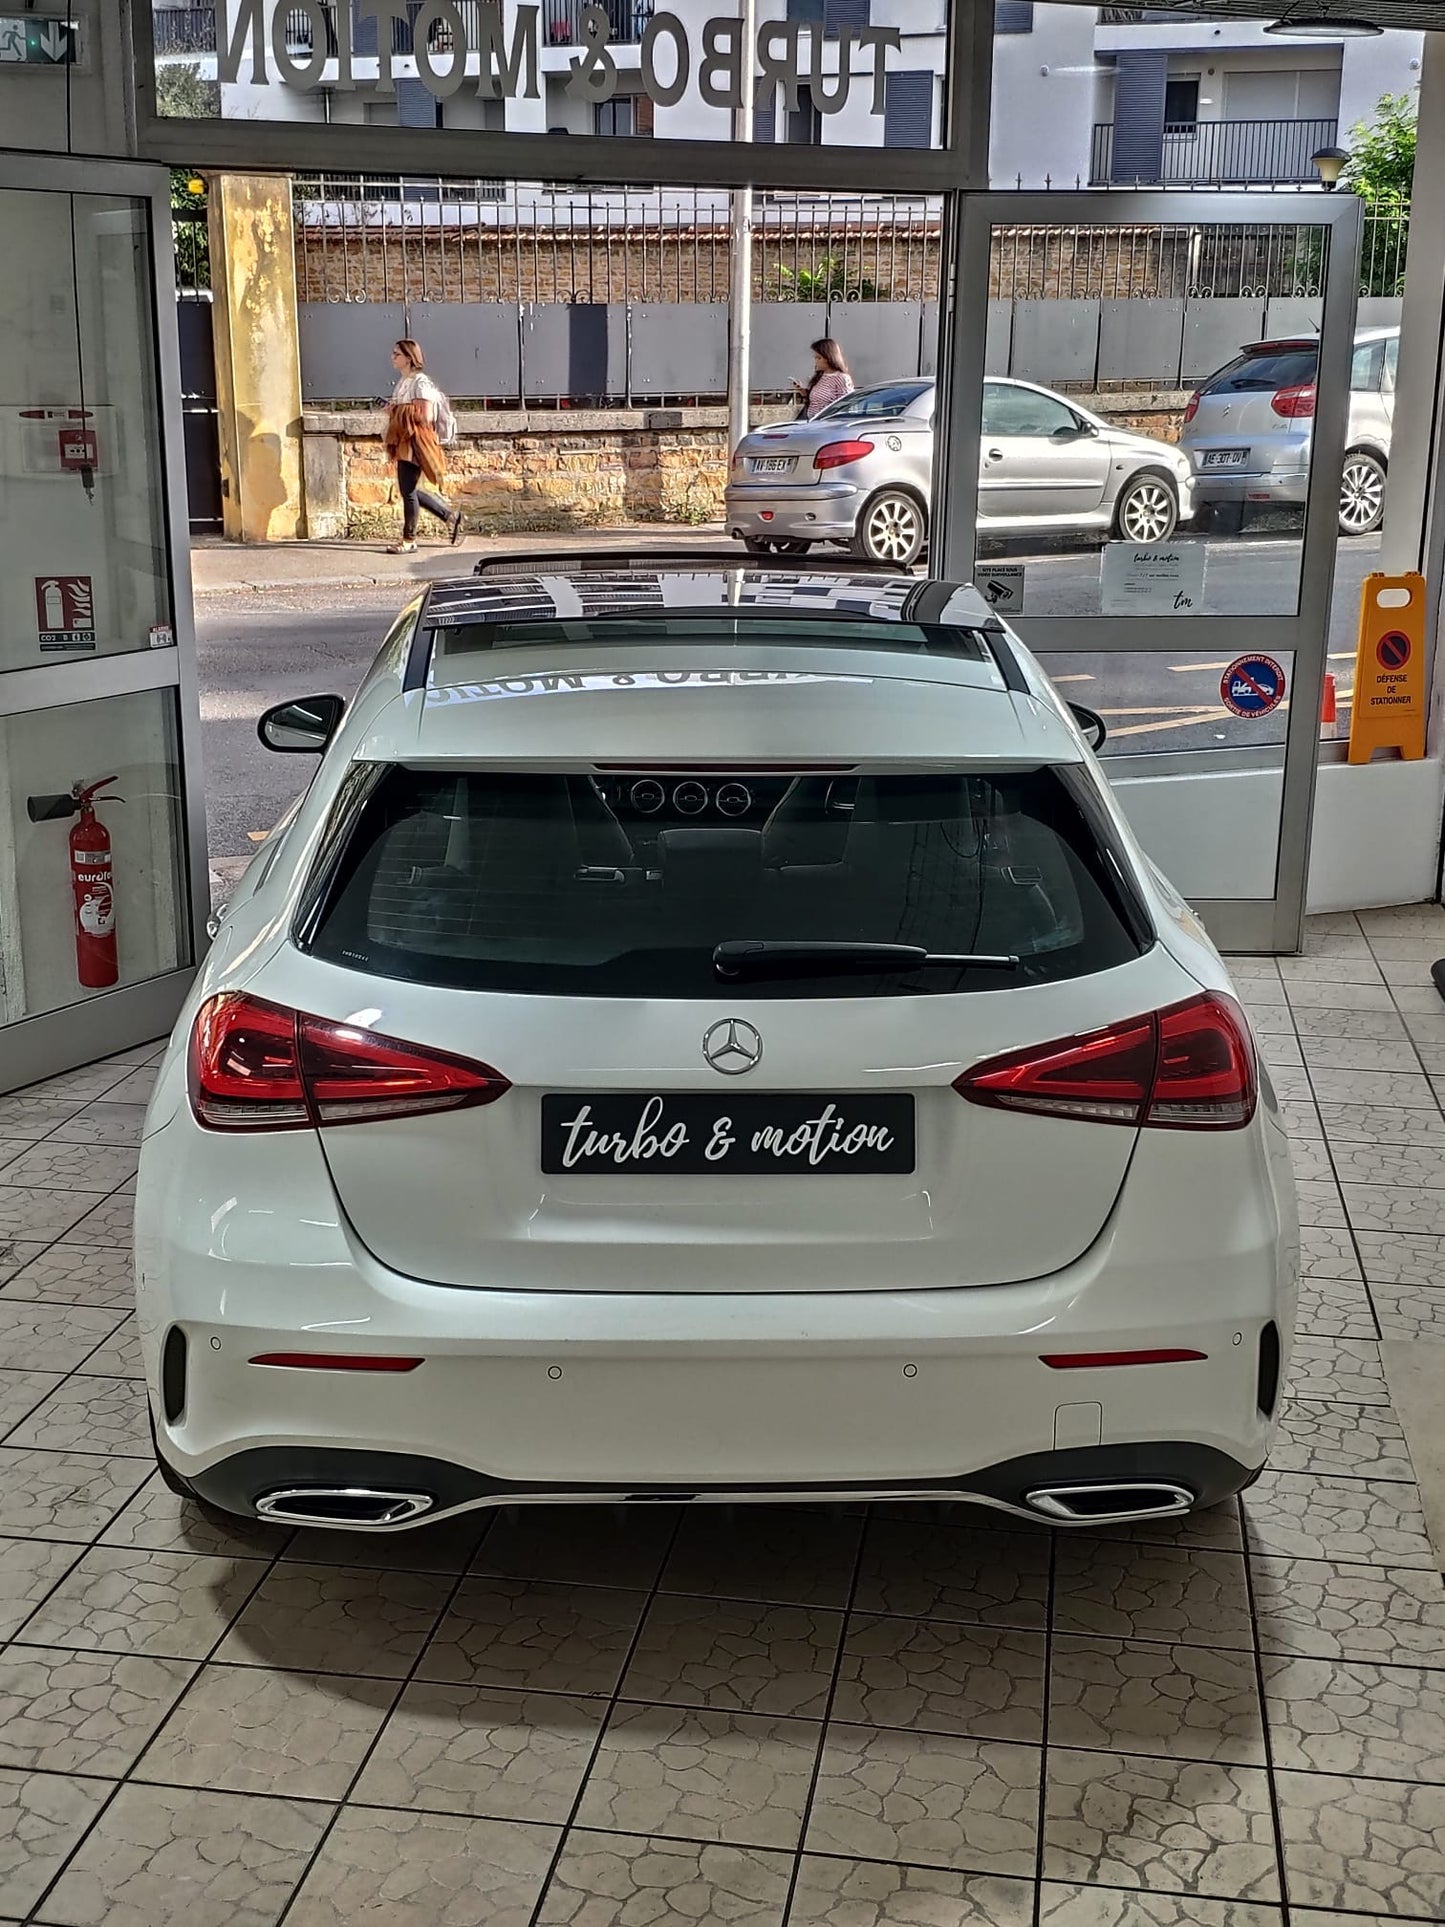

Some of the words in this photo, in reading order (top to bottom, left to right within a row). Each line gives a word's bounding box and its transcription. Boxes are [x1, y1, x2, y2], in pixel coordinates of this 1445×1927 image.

[40, 634, 56, 642] CO2
[1223, 655, 1265, 684] STATIONNEMENT
[1264, 657, 1284, 681] INTERDIT
[1376, 673, 1408, 683] DÉFENSE
[1386, 685, 1397, 694] DE
[1224, 697, 1241, 715] SORTIE
[1370, 696, 1412, 706] STATIONNER
[560, 1095, 690, 1168] turbo
[704, 1116, 736, 1161] &
[750, 1103, 894, 1166] motion
